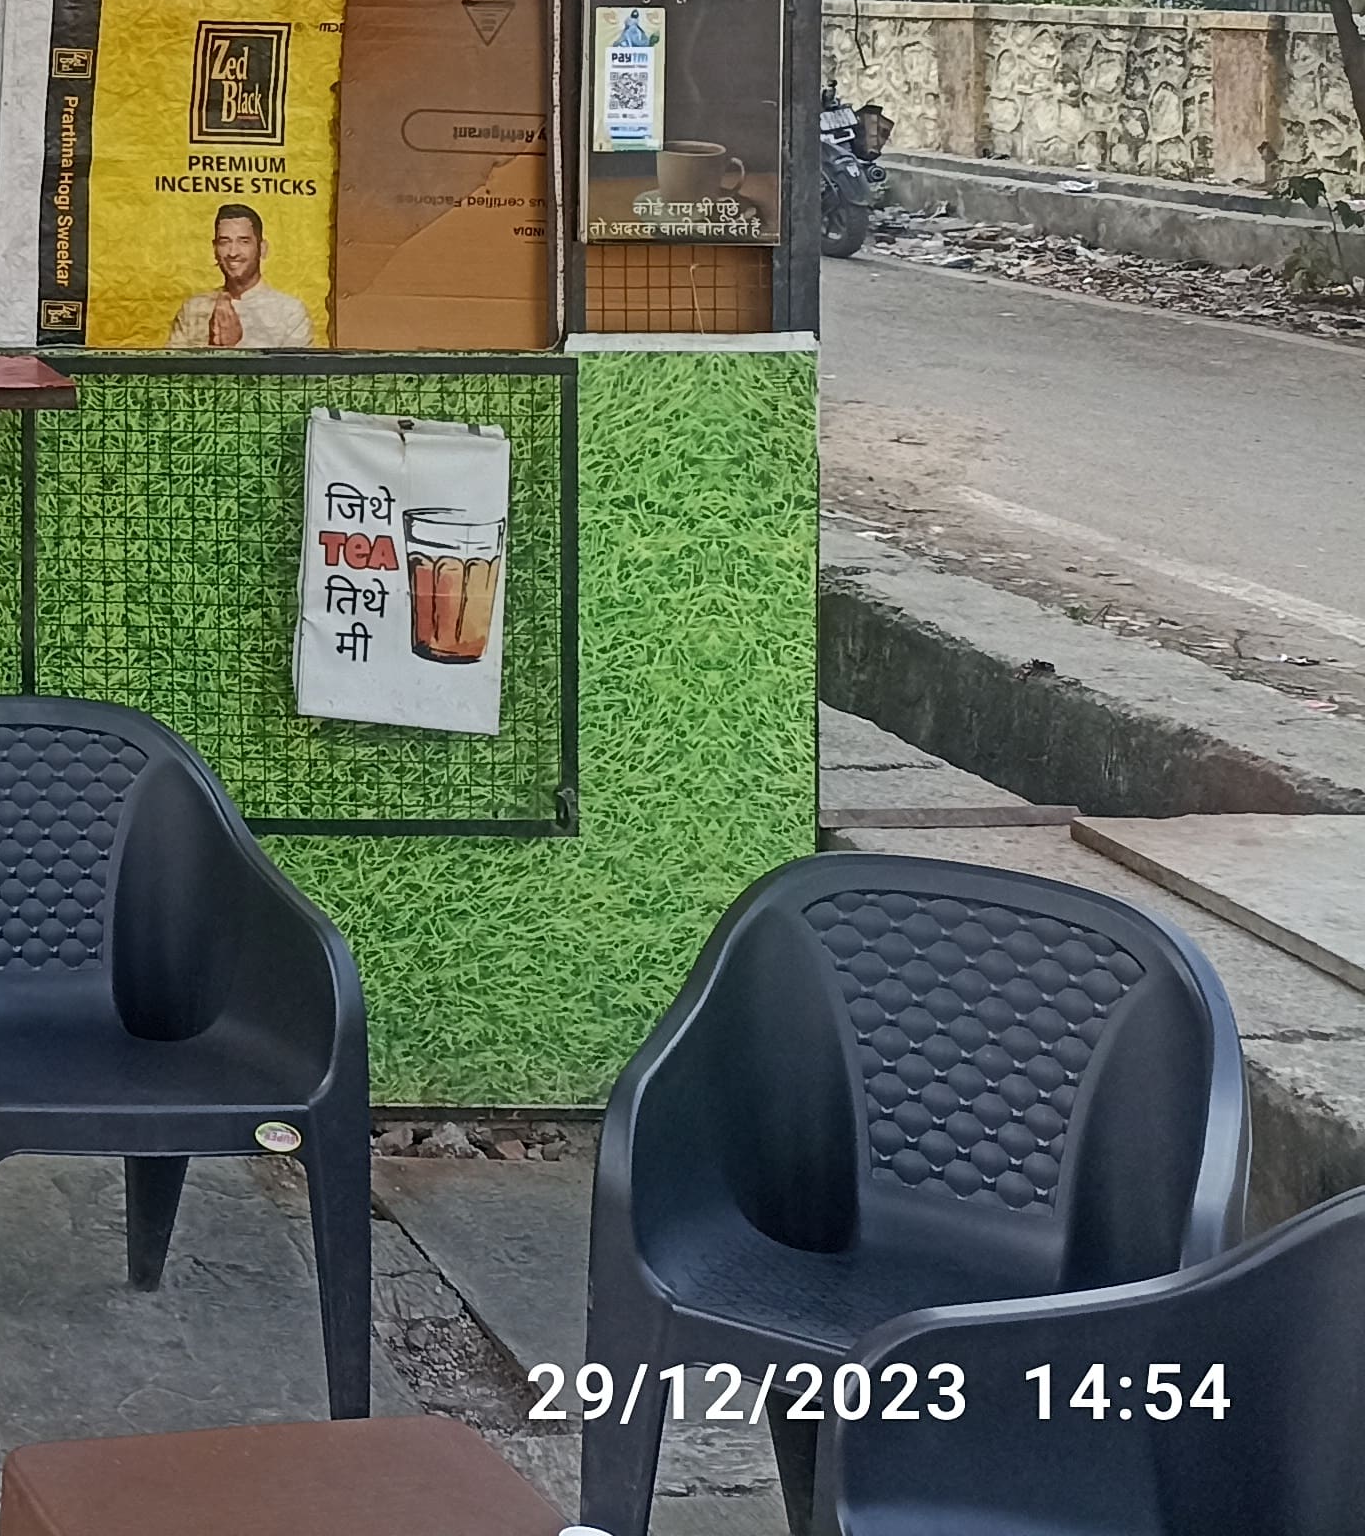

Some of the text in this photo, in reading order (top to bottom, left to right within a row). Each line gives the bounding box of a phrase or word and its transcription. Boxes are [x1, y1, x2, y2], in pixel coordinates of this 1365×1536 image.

[211, 39, 248, 80] Zed
[222, 80, 267, 128] Black
[155, 176, 316, 195] INCENSE STICKS
[188, 155, 286, 173] PREMIUM
[54, 95, 78, 287] Prarthna Hogi Sweekar
[325, 482, 395, 525] जिथे
[325, 575, 389, 618] तिथे
